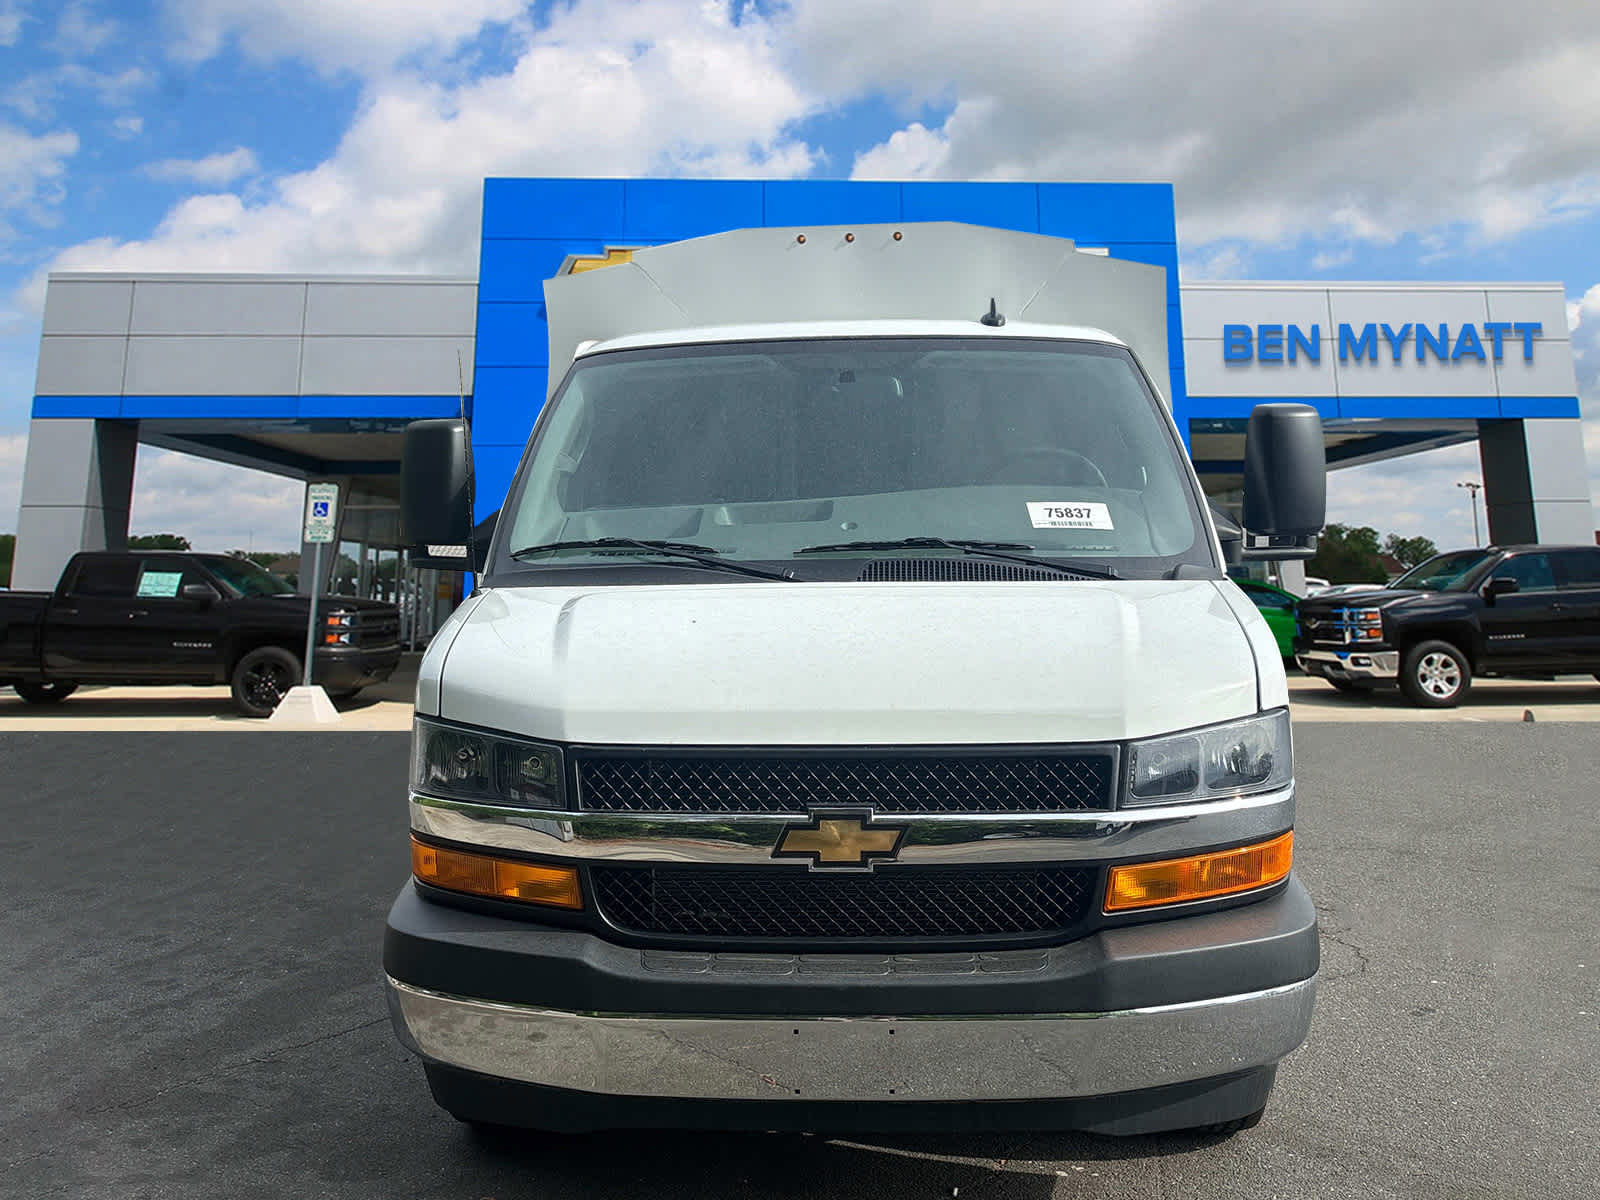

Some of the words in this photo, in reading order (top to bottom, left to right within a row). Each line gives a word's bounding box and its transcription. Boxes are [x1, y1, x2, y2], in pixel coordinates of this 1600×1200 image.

[1223, 323, 1321, 360] BEN
[1338, 322, 1543, 360] MYNATT
[1043, 507, 1092, 519] 75837
